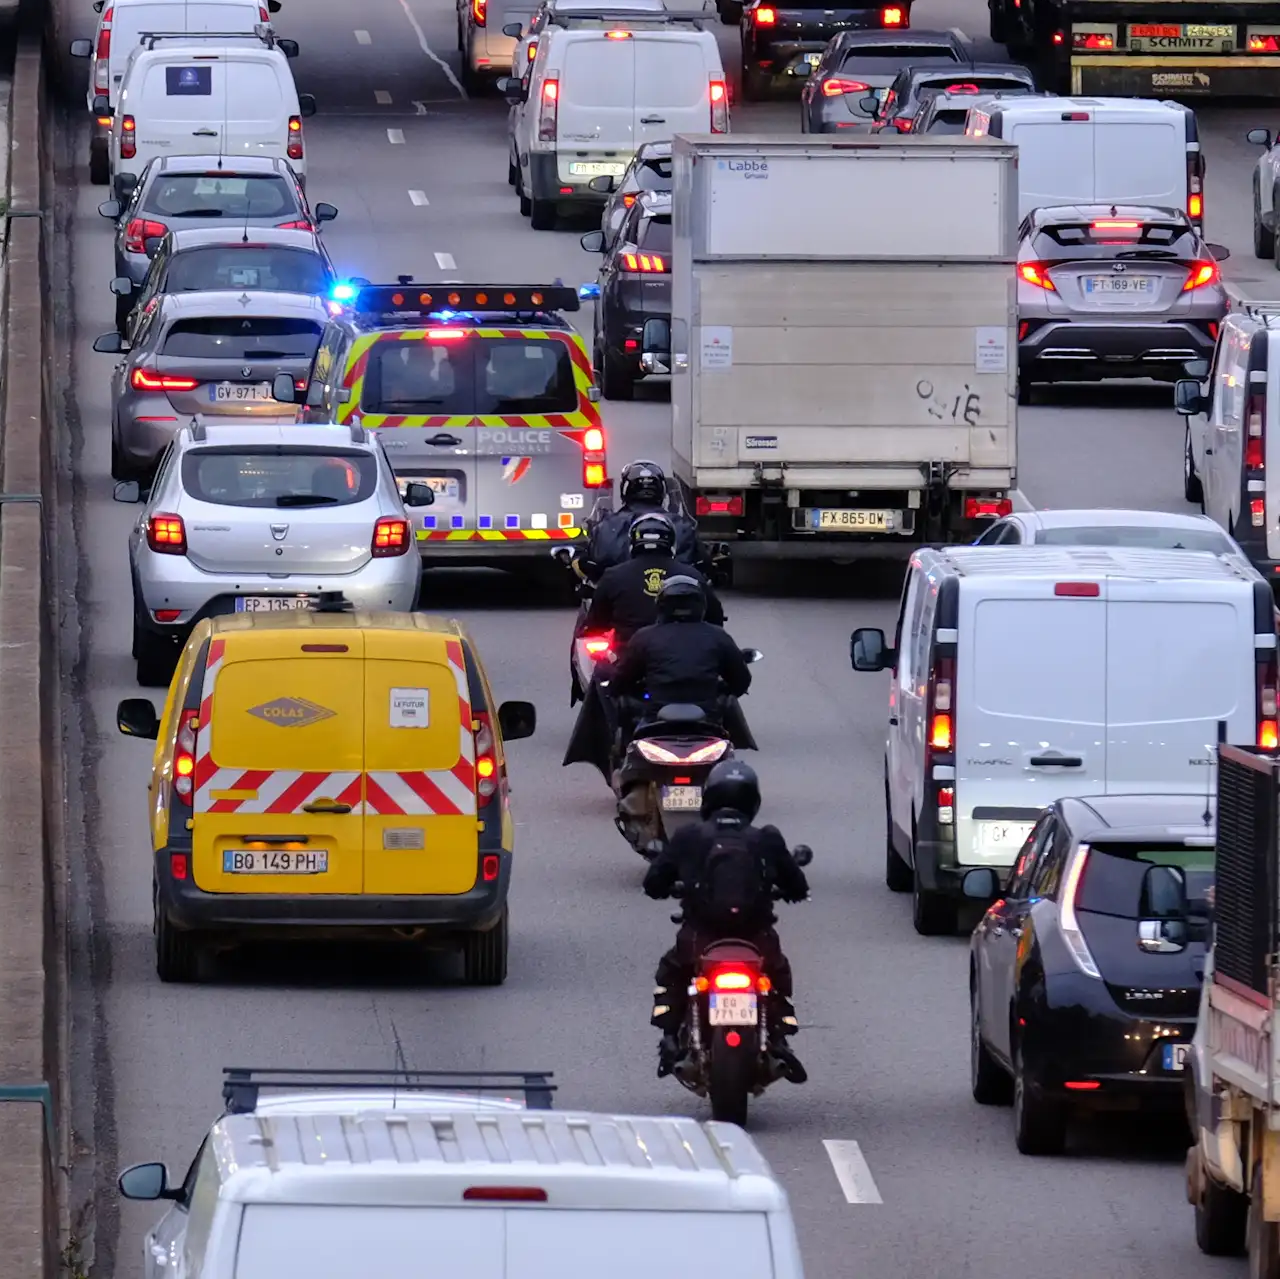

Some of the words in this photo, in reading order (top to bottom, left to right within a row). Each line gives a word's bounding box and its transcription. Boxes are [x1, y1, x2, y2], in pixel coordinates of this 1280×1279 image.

[1150, 37, 1214, 47] SCHMITZ
[218, 387, 273, 399] GV-971-J
[478, 431, 551, 443] POLICE
[264, 708, 304, 717] COLAS
